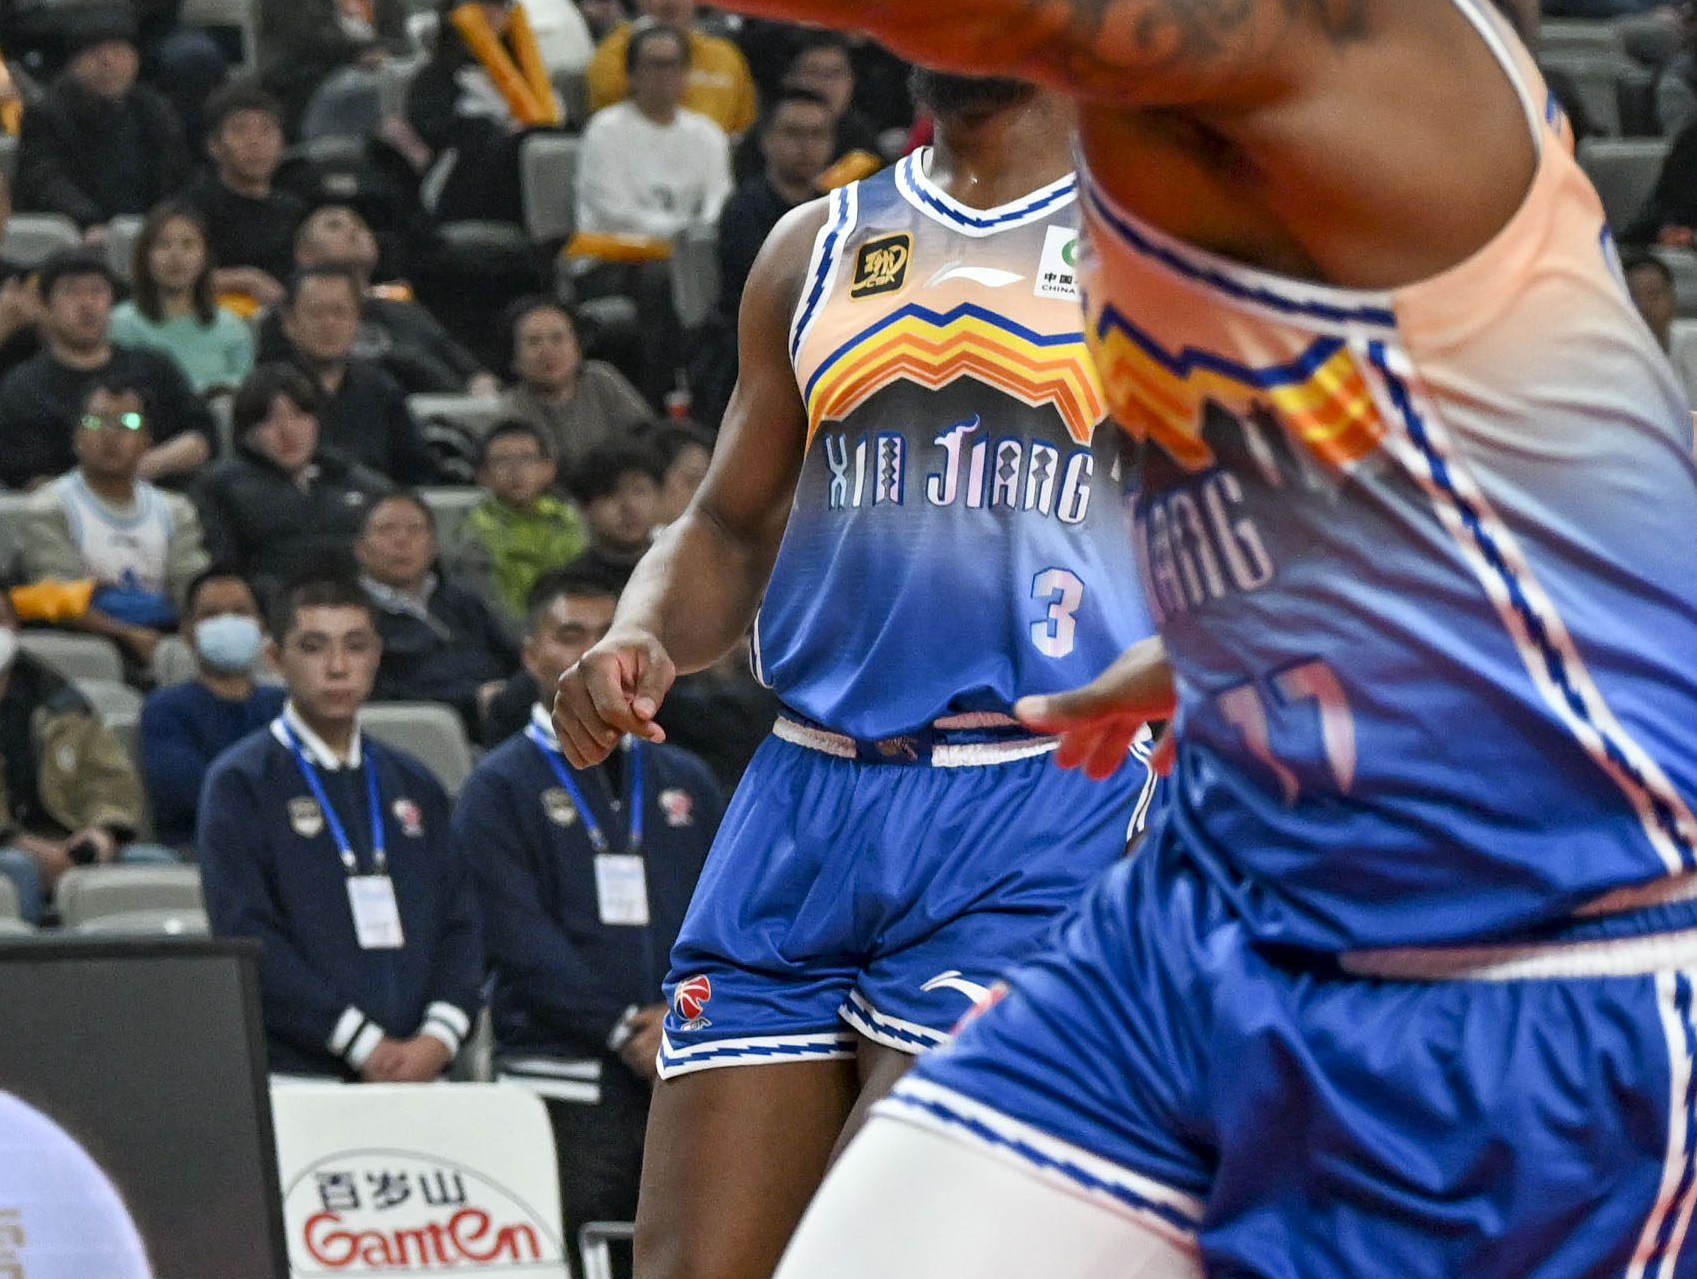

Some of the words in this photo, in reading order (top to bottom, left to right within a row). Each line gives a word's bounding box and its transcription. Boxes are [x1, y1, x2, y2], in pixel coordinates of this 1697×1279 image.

[1041, 284, 1076, 295] CHINA
[1044, 272, 1079, 285] 中国
[1029, 566, 1087, 659] 3
[315, 1170, 468, 1212] 百岁山
